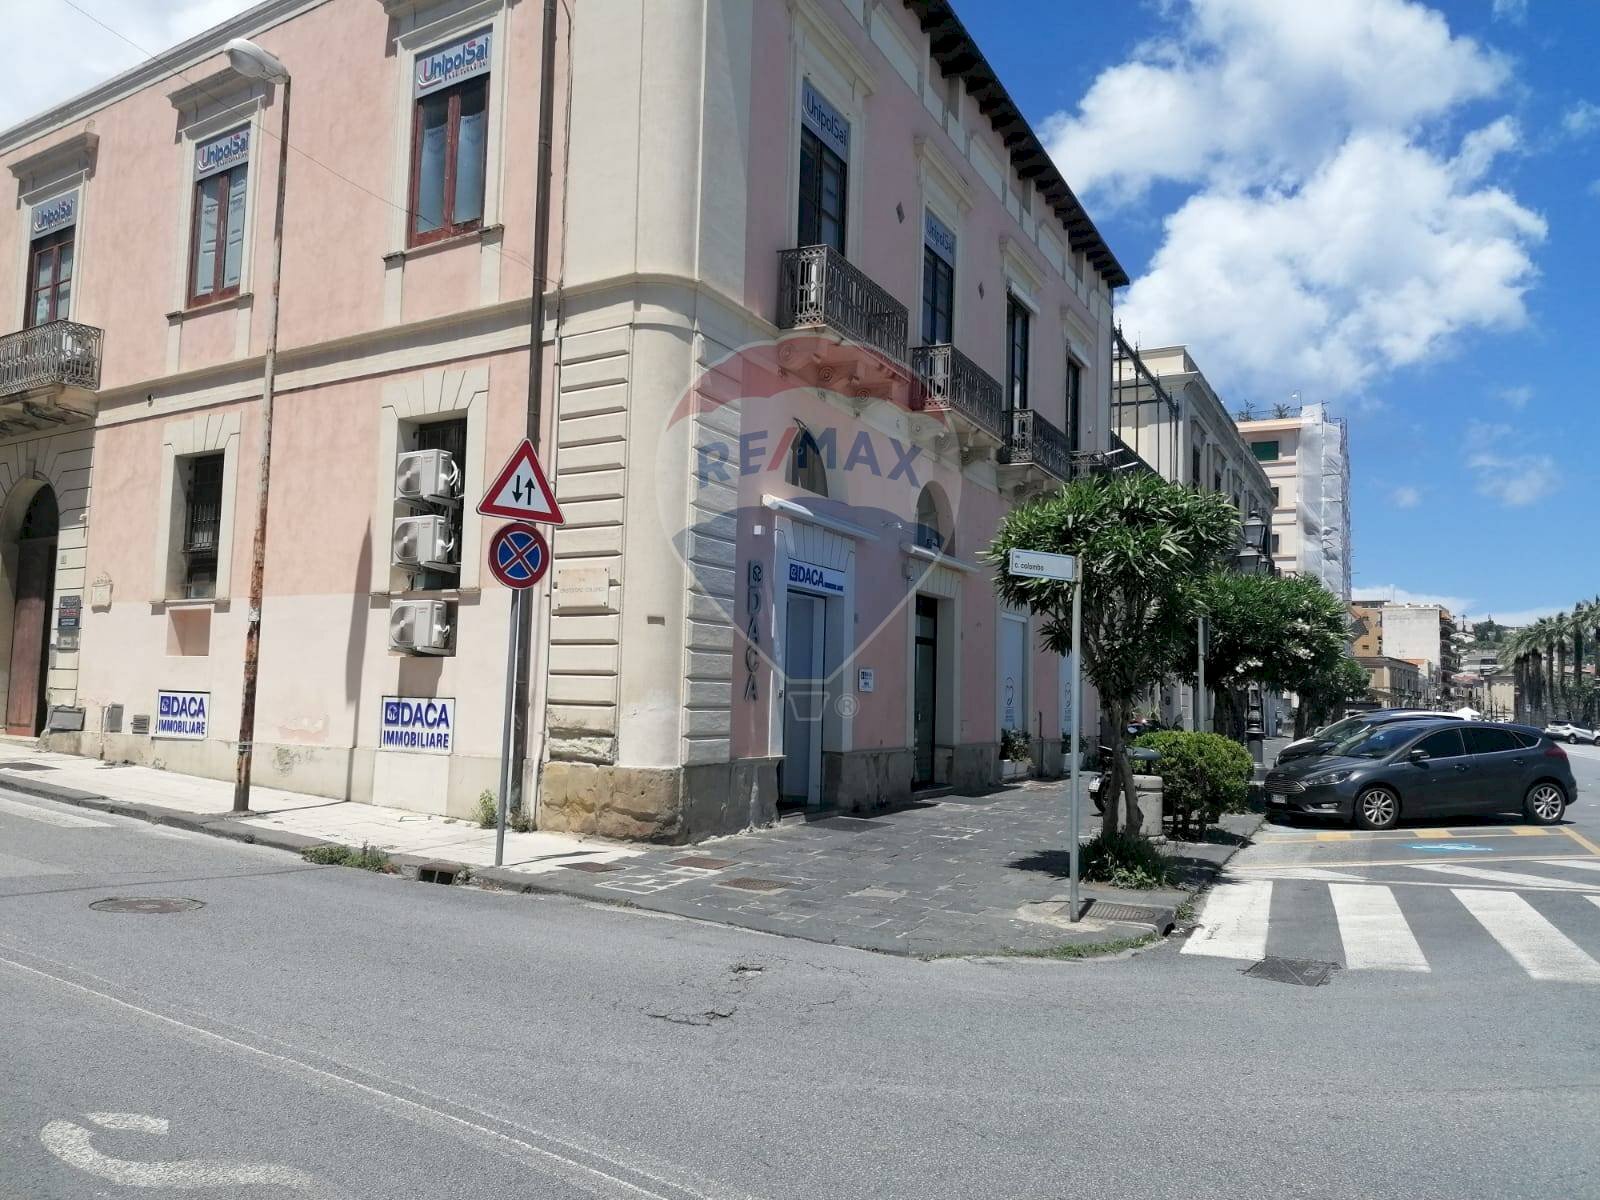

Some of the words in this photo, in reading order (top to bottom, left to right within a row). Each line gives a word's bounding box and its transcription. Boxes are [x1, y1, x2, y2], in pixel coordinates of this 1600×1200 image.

[421, 36, 489, 84] UnipolSai
[805, 91, 848, 145] UnipolSai
[199, 131, 250, 169] UnipolSai
[798, 565, 824, 587] DACA
[171, 696, 206, 718] DACA
[400, 702, 449, 728] DACA
[158, 719, 206, 735] IMMOBILIARE
[383, 730, 449, 749] IMMOBILIARE
